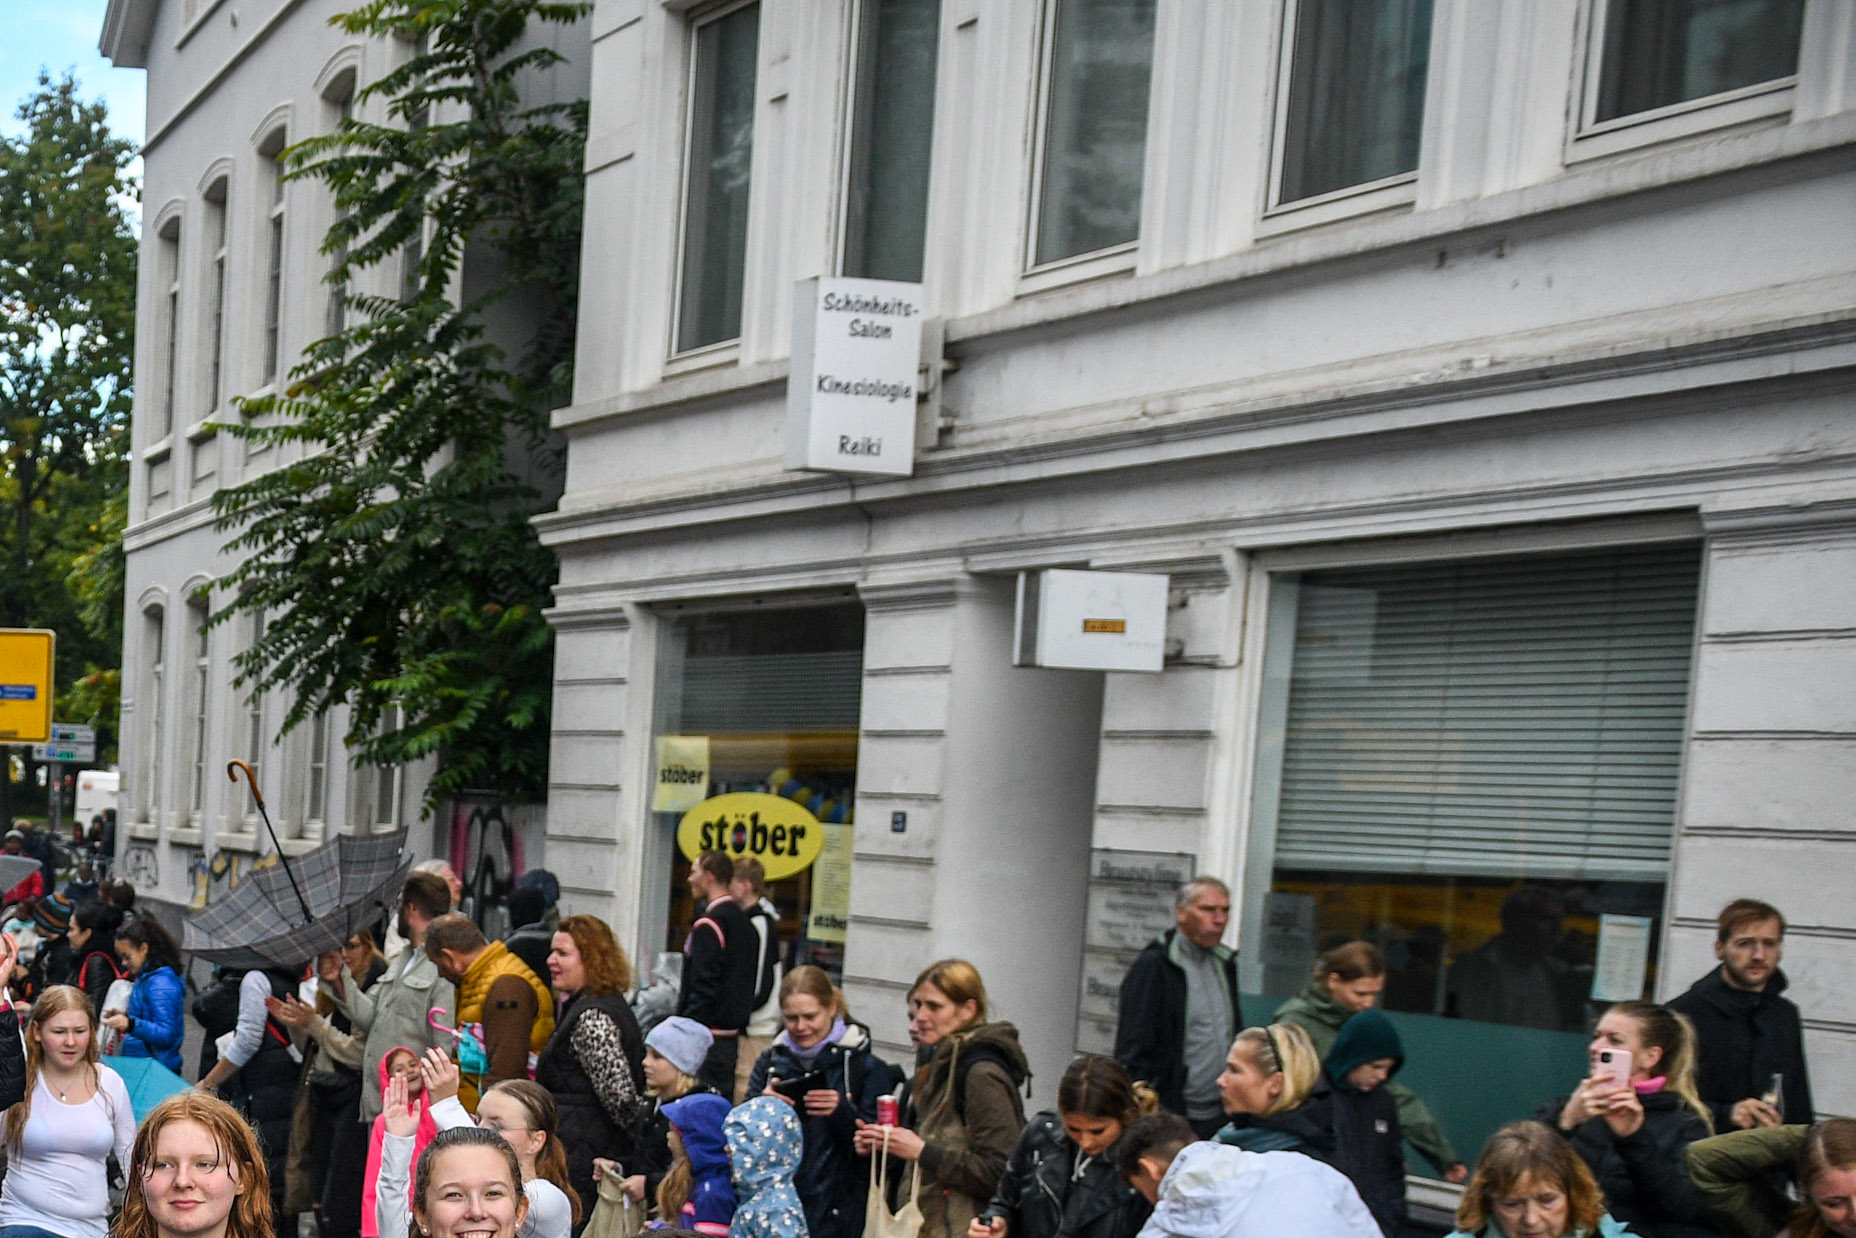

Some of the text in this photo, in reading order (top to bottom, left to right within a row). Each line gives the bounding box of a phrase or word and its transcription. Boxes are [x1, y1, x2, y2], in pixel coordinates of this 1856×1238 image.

[822, 291, 919, 317] Schönheits-
[848, 319, 892, 339] Salon
[817, 375, 913, 403] Kinesiologie
[838, 434, 882, 456] Reiki
[660, 764, 705, 785] stöber
[699, 810, 807, 857] stöber
